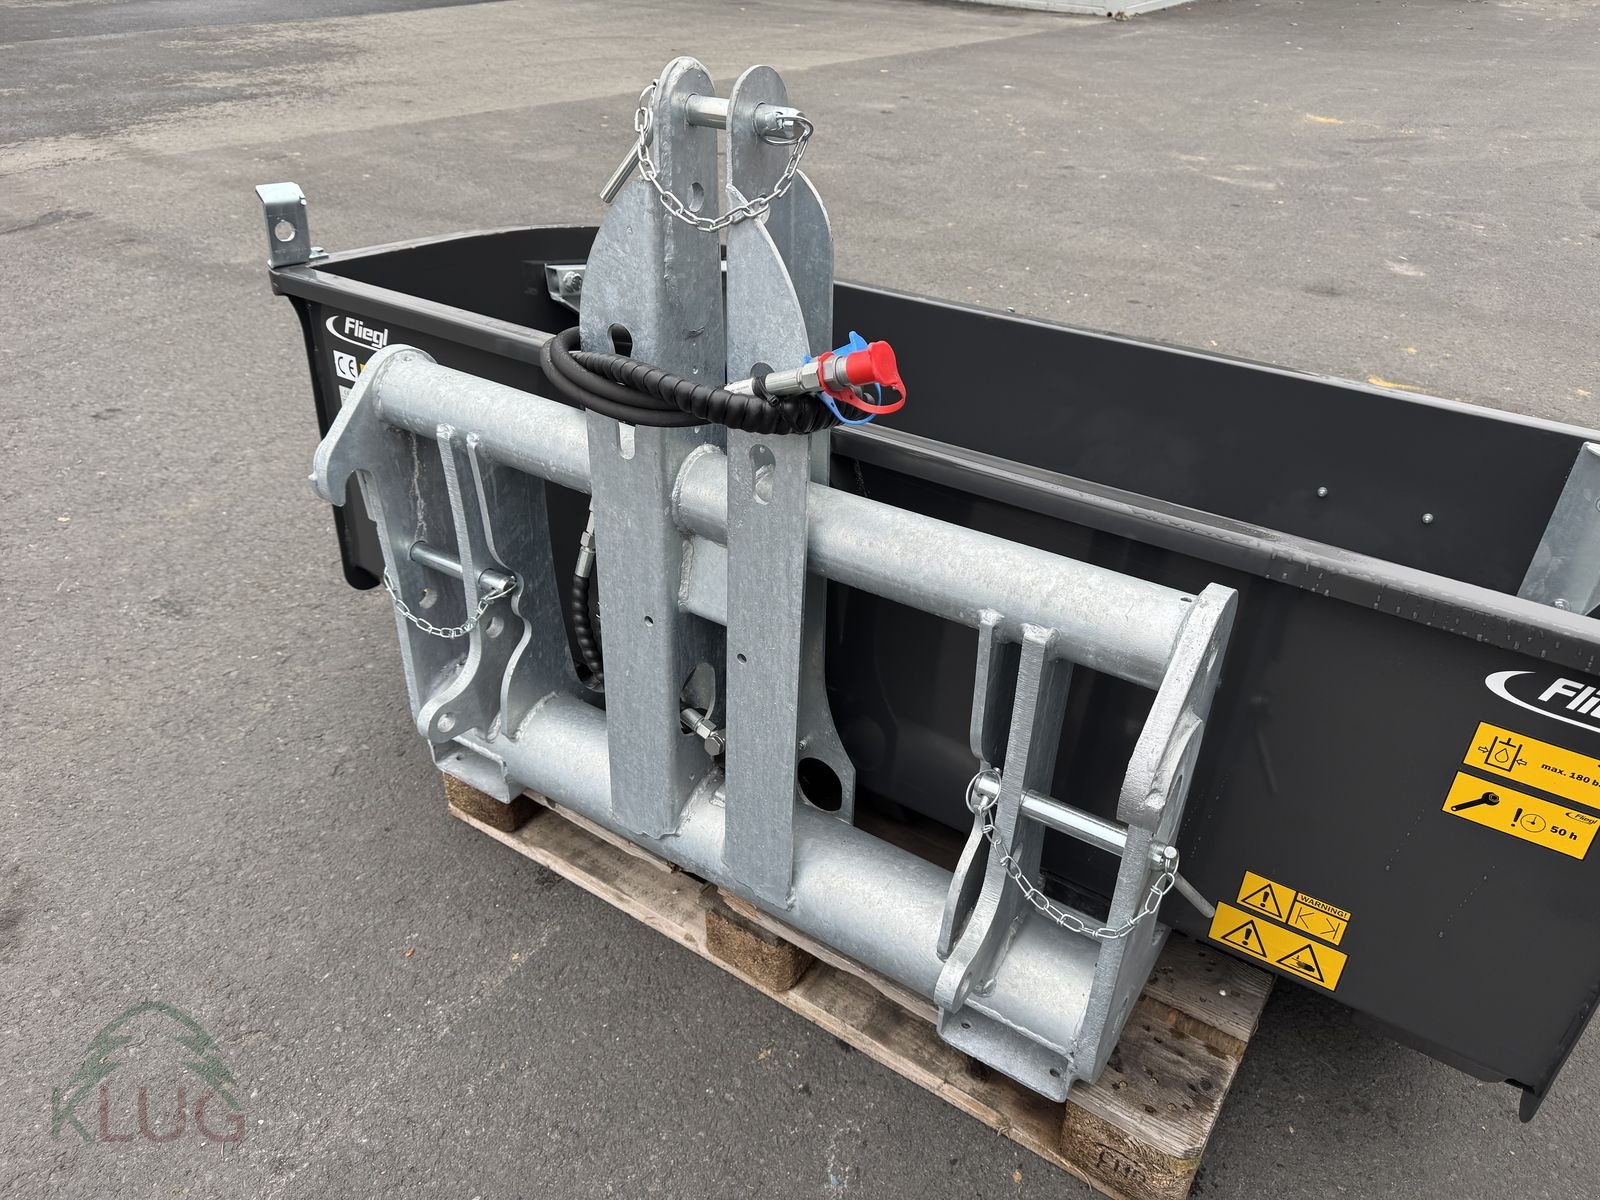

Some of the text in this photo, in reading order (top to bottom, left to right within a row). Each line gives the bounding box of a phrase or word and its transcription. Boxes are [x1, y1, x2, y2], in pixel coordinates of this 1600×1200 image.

[344, 316, 389, 349] Fliegl
[1541, 763, 1600, 788] max. 180 b
[1574, 813, 1598, 825] Fliegl
[1550, 825, 1578, 841] 50 h
[1300, 894, 1348, 919] WARNING!
